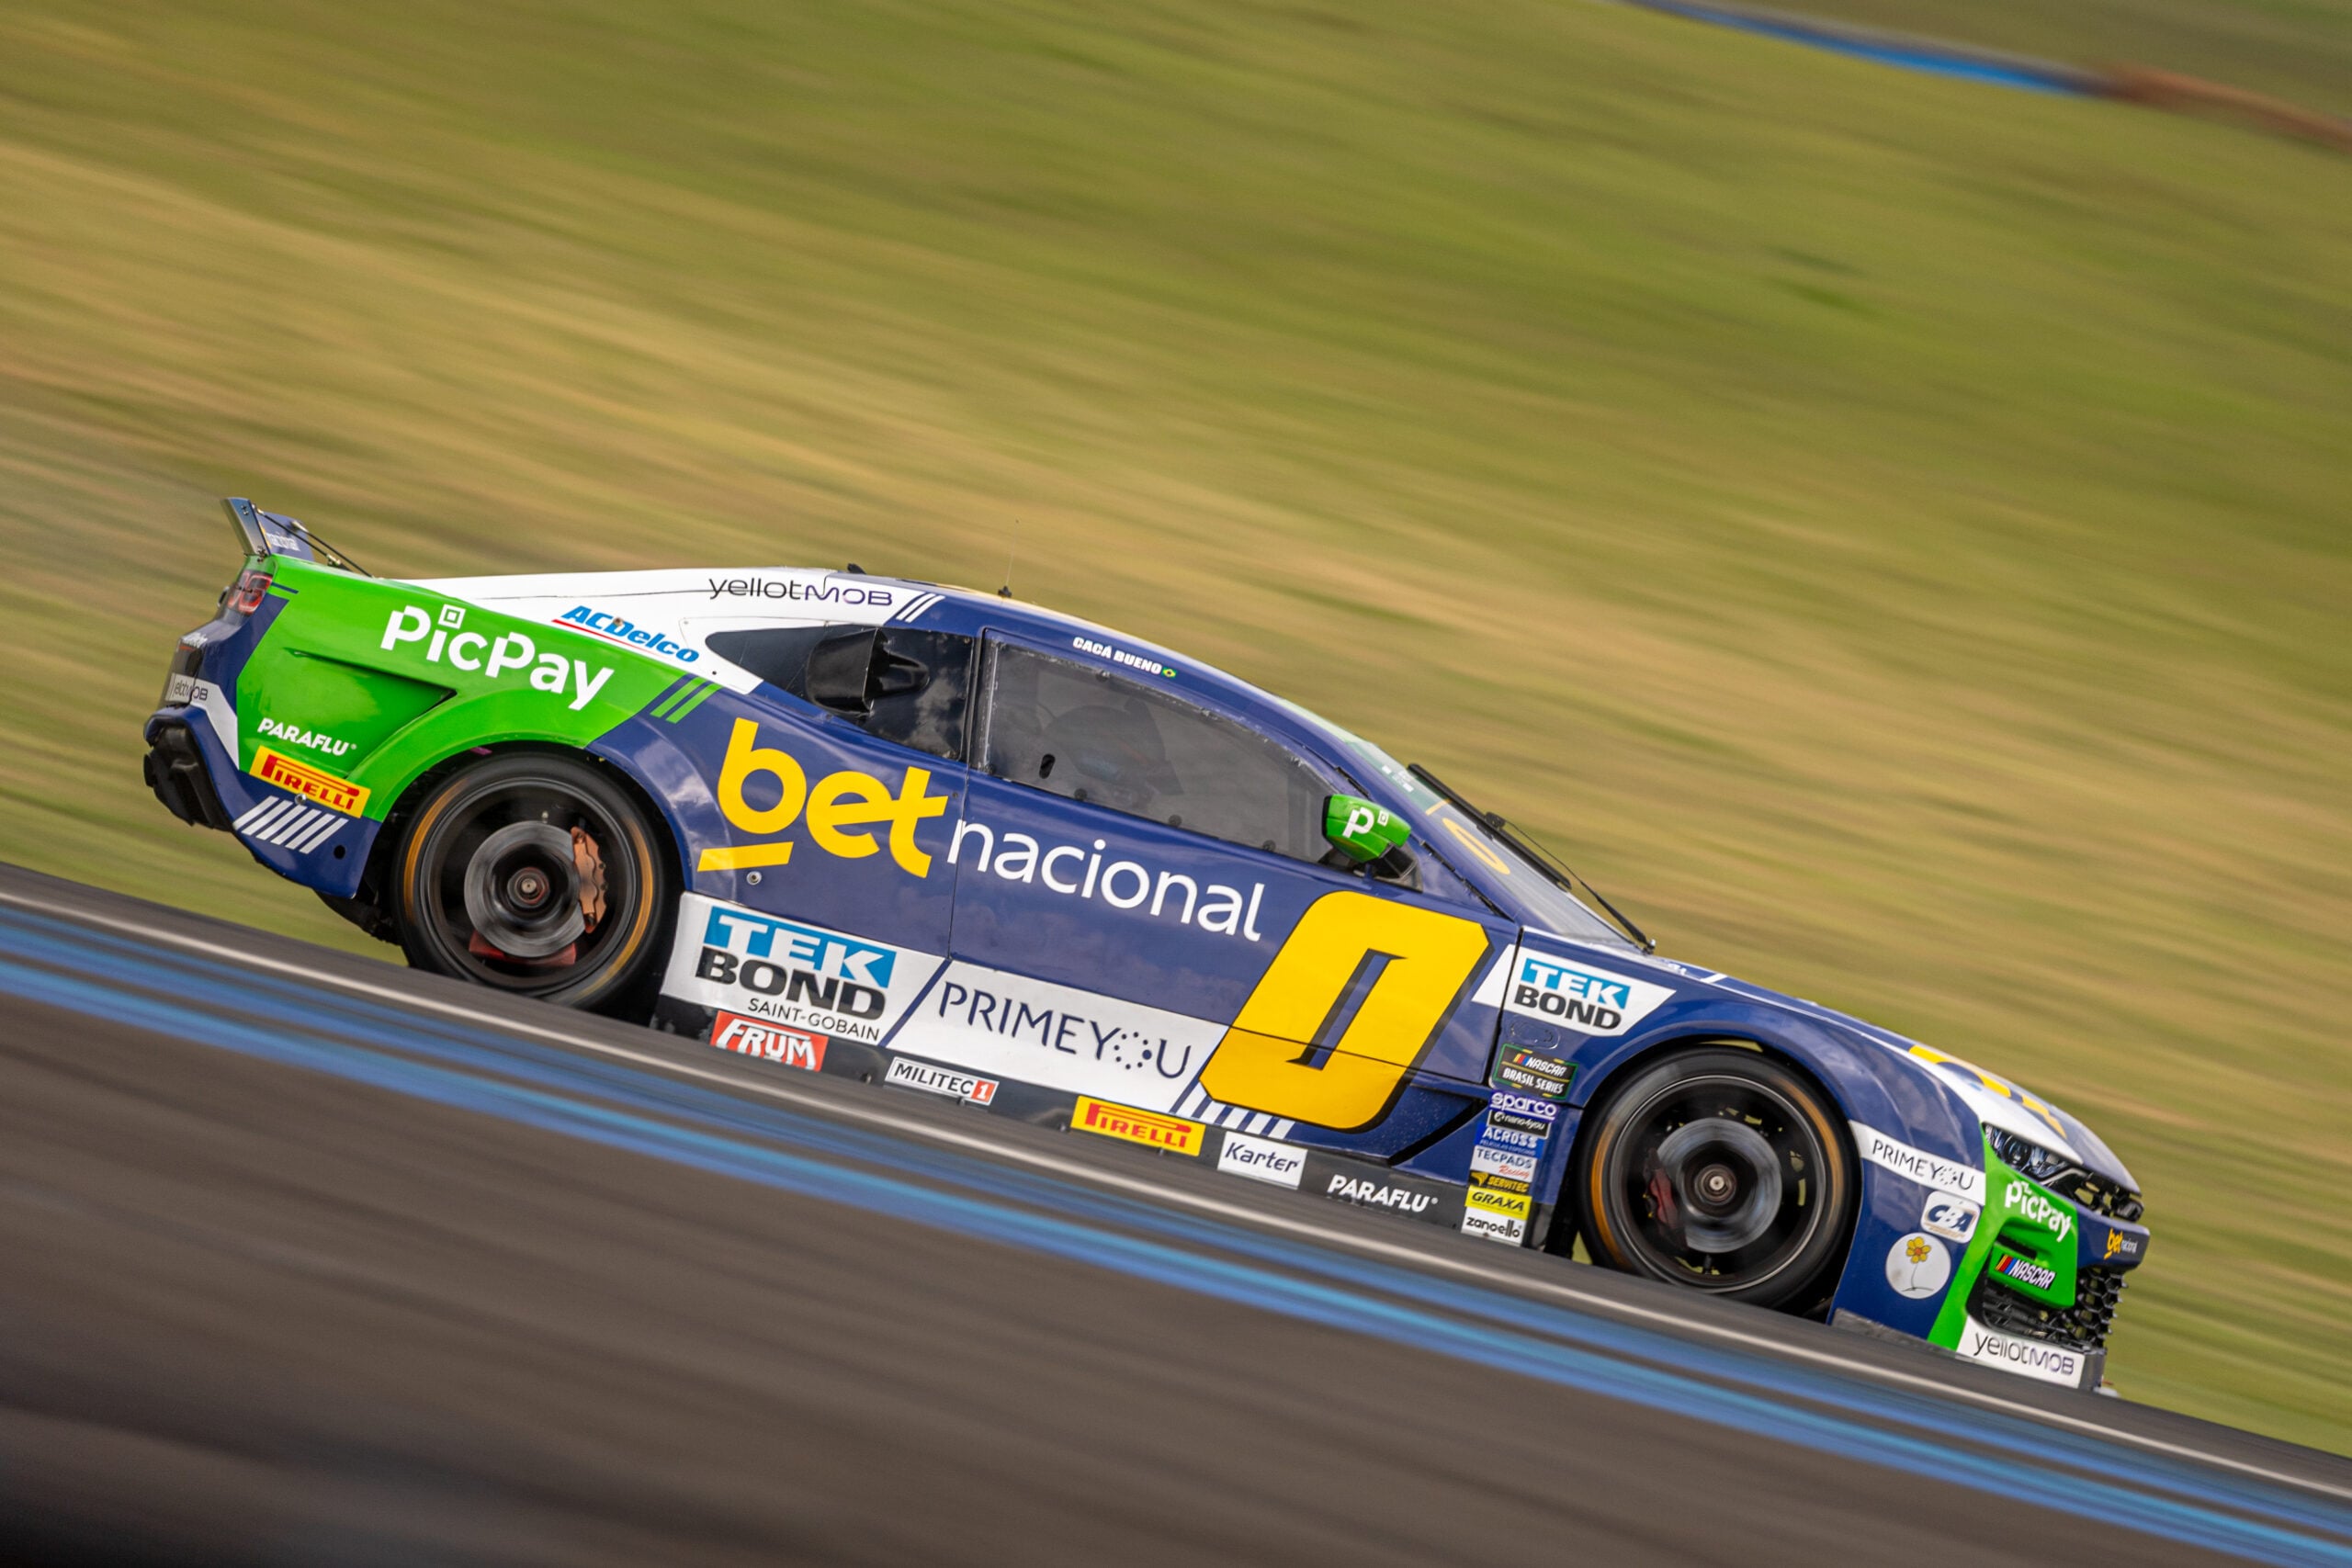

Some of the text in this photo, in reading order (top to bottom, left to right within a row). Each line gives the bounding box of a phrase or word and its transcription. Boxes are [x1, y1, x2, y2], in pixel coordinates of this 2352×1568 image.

[709, 577, 892, 607] yellotMOB
[560, 605, 700, 663] ACDelco
[1072, 637, 1162, 675] CACÁ BUENO
[379, 604, 615, 711] PicPay
[261, 754, 360, 810] PIRELLI
[718, 717, 1265, 942] bet nacional
[718, 914, 885, 984] TEK
[695, 946, 887, 1021] BOND
[1529, 963, 1623, 1009] TEK
[747, 998, 880, 1042] SAINT-GOBAIN
[939, 981, 1192, 1078] PRIMEYOU
[1199, 891, 1493, 1131] 0
[1514, 985, 1622, 1030] BOND
[716, 1019, 818, 1070] FRUM
[1524, 1056, 1567, 1077] NASCAR
[894, 1064, 974, 1096] MILITEC
[1502, 1067, 1565, 1094] BRASIL SERIES
[1085, 1102, 1193, 1149] PIRELLI
[1491, 1091, 1557, 1117] sparco
[1225, 1142, 1300, 1174] Karter
[1476, 1148, 1533, 1169] TECPADS
[1482, 1127, 1538, 1149] ACROSS
[1472, 1191, 1525, 1212] GRAXA
[2005, 1180, 2073, 1243] PicPay
[1466, 1216, 1521, 1238] zanoello
[2105, 1227, 2124, 1254] bet
[2007, 1259, 2056, 1290] NASCAR
[1973, 1332, 2075, 1376] yellotMOB
